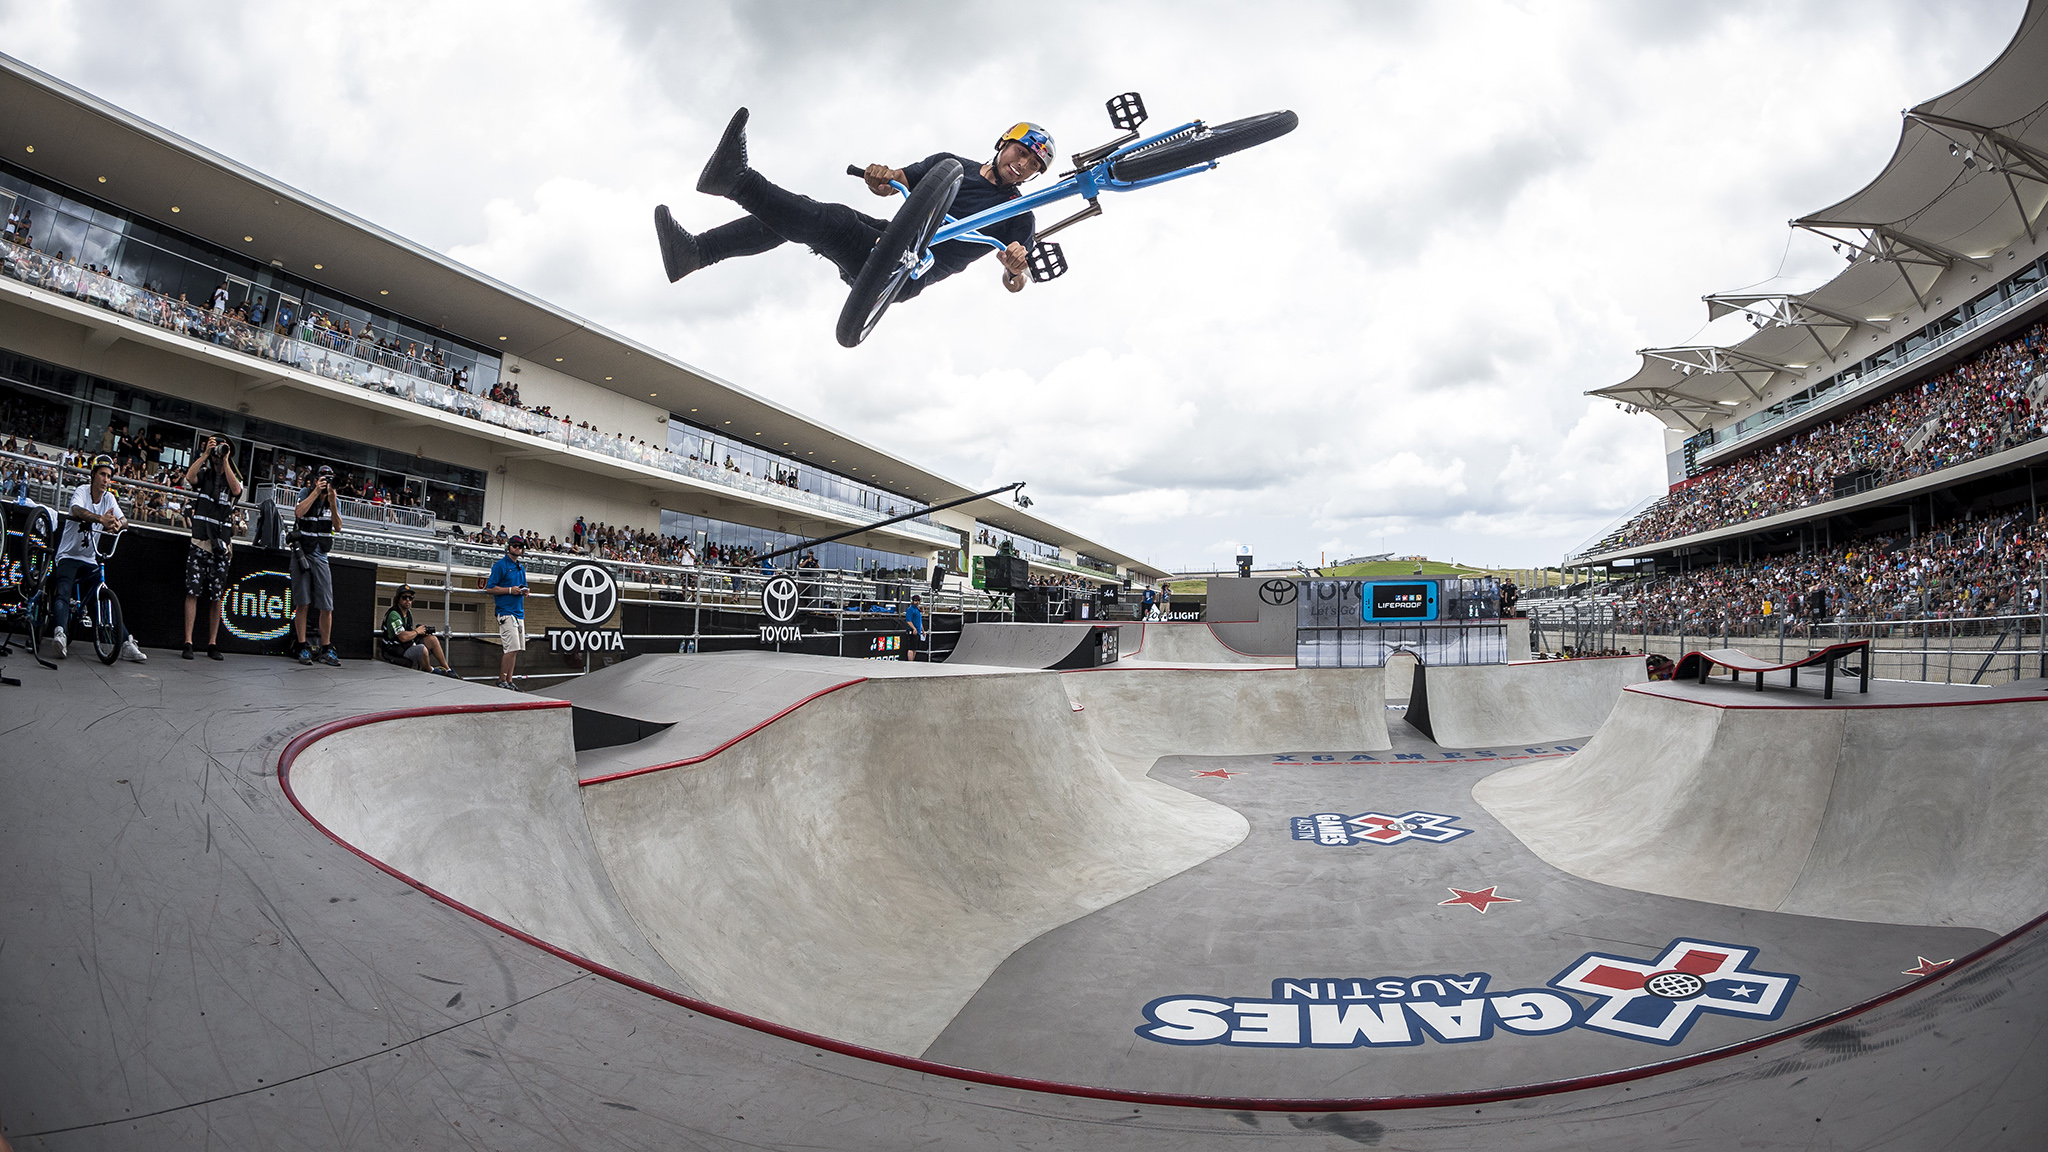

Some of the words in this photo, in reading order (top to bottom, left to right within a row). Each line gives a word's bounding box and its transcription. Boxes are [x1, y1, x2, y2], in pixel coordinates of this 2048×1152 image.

[232, 584, 291, 618] intel
[1311, 605, 1337, 616] Let's
[1340, 606, 1356, 615] Go
[548, 630, 625, 651] TOYOTA
[760, 626, 802, 641] TOYOTA
[1272, 744, 1586, 762] XGAMES.CO
[1315, 814, 1349, 845] GAMES
[1283, 976, 1481, 999] AUSTIN
[1148, 992, 1572, 1043] GAMES
